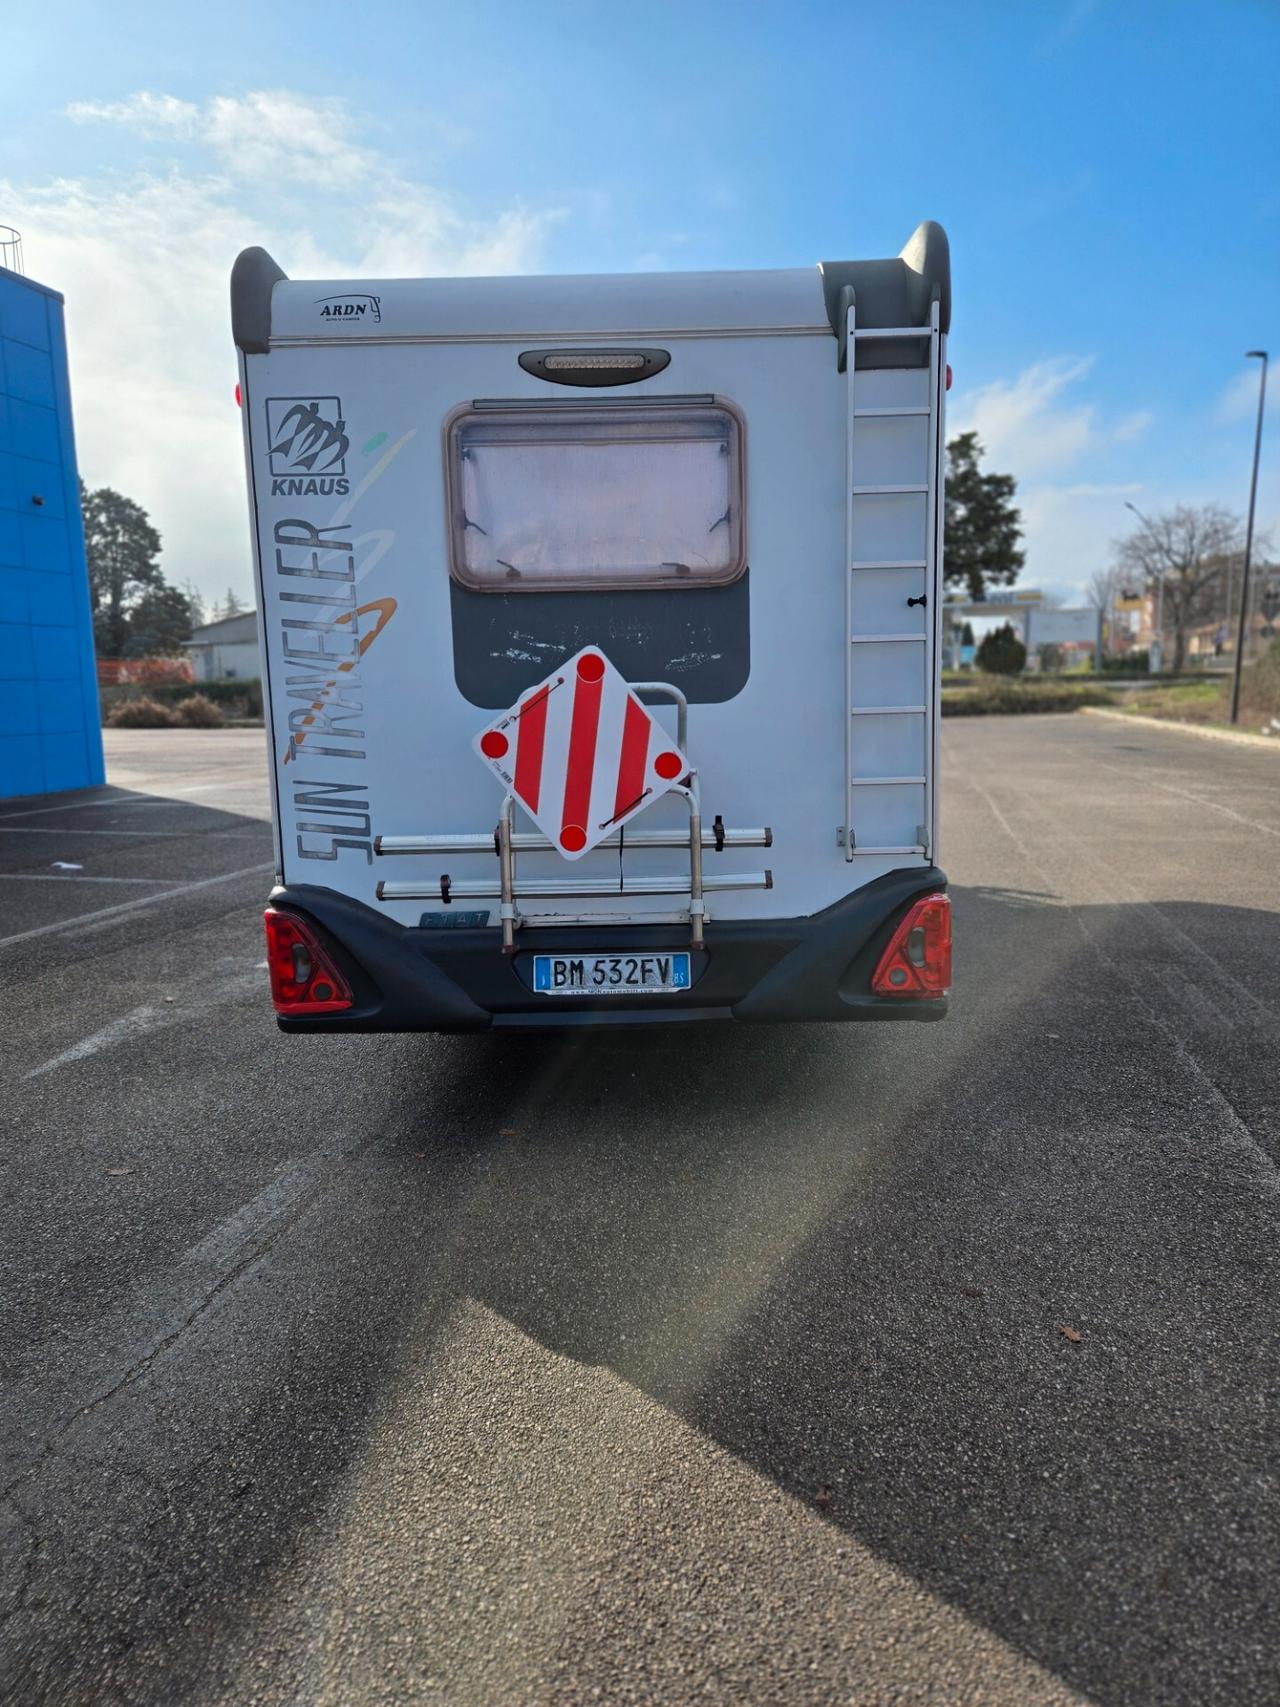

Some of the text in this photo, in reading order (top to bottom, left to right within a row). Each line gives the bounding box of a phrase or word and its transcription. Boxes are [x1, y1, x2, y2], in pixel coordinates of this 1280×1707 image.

[320, 304, 367, 316] ARDN
[271, 478, 350, 496] KNAUS
[273, 518, 374, 866] SUN TRAVELLER
[424, 912, 486, 927] FIAT
[553, 959, 585, 986] BM
[592, 958, 670, 985] 532FV
